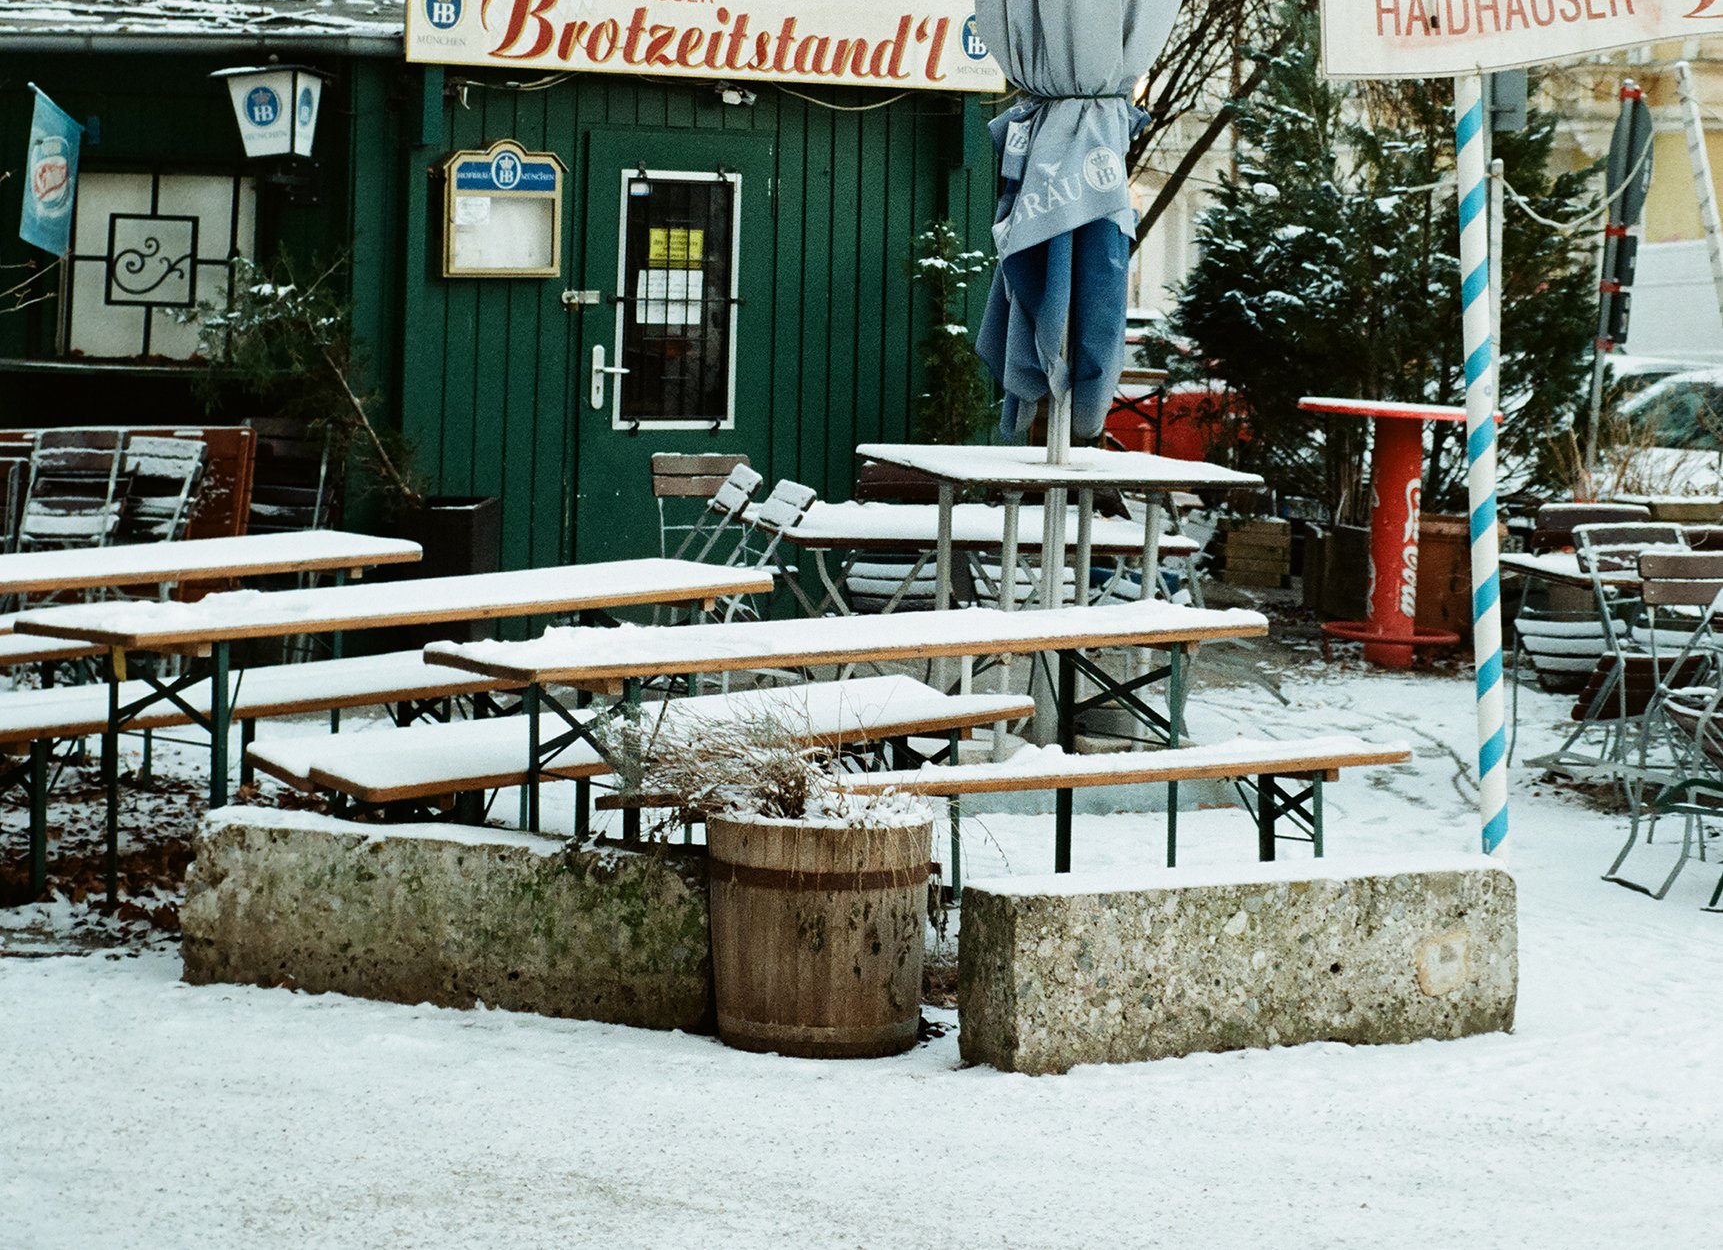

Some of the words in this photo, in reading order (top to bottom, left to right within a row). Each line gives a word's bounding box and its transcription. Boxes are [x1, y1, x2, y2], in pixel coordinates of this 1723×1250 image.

[432, 2, 456, 23] HB
[416, 34, 467, 47] MÜNCHEN
[253, 105, 274, 122] HB
[500, 170, 514, 183] HB
